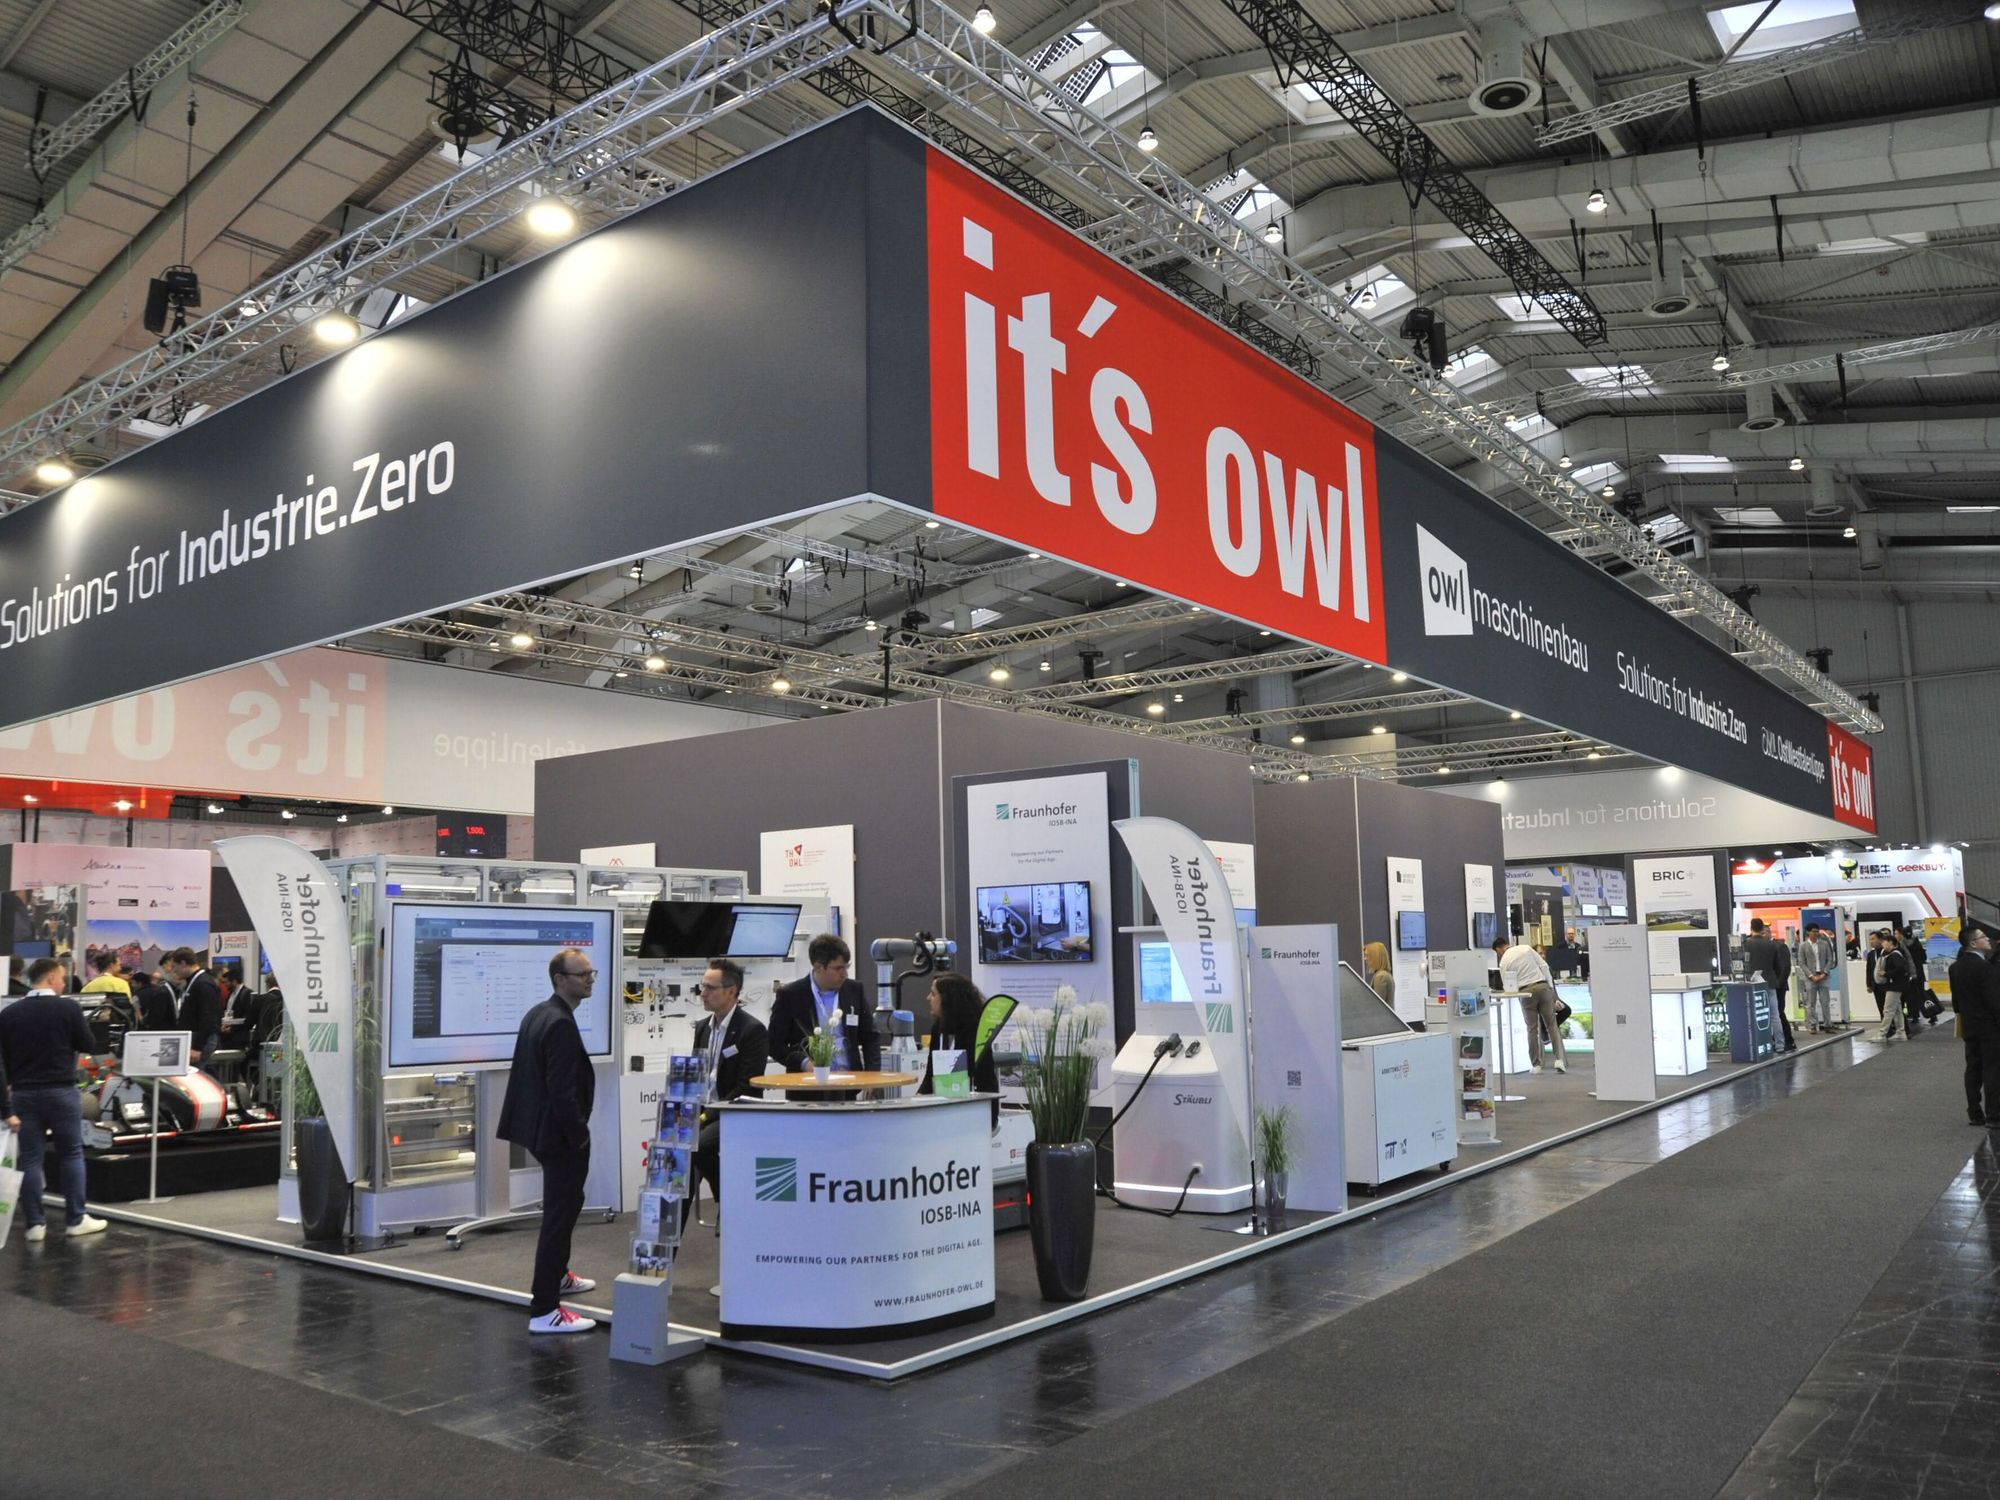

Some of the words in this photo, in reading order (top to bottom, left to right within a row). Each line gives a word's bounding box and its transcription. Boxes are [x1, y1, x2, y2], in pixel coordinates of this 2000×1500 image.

[1205, 426, 1371, 624] owl
[0, 573, 118, 649] Solutions
[127, 545, 170, 603] for
[178, 441, 455, 586] Industrie.Zero
[1428, 566, 1465, 616] owl
[1473, 588, 1589, 672] maschinenbau
[1617, 651, 1672, 710] Solutions
[1672, 677, 1687, 716] for
[1689, 687, 1747, 745] Industrie.Zero
[1852, 756, 1873, 821] owl
[1012, 802, 1077, 819] Fraunhofer
[1049, 818, 1077, 827] IOSB-INA
[1652, 870, 1685, 881] BRIC
[1273, 949, 1320, 959] Fraunhofer
[809, 1160, 981, 1203] Fraunhofer
[920, 1200, 982, 1226] IOSB-INA
[755, 1254, 822, 1265] EMPOWERING
[826, 1256, 847, 1265] OUR
[850, 1253, 899, 1264] PARTNERS
[903, 1251, 919, 1260] FOR
[921, 1248, 935, 1258] THE
[937, 1242, 965, 1255] DIGITAL
[967, 1239, 983, 1249] AGE.
[874, 1280, 984, 1308] WWW.FRAUNHOFER-OWL.DE
